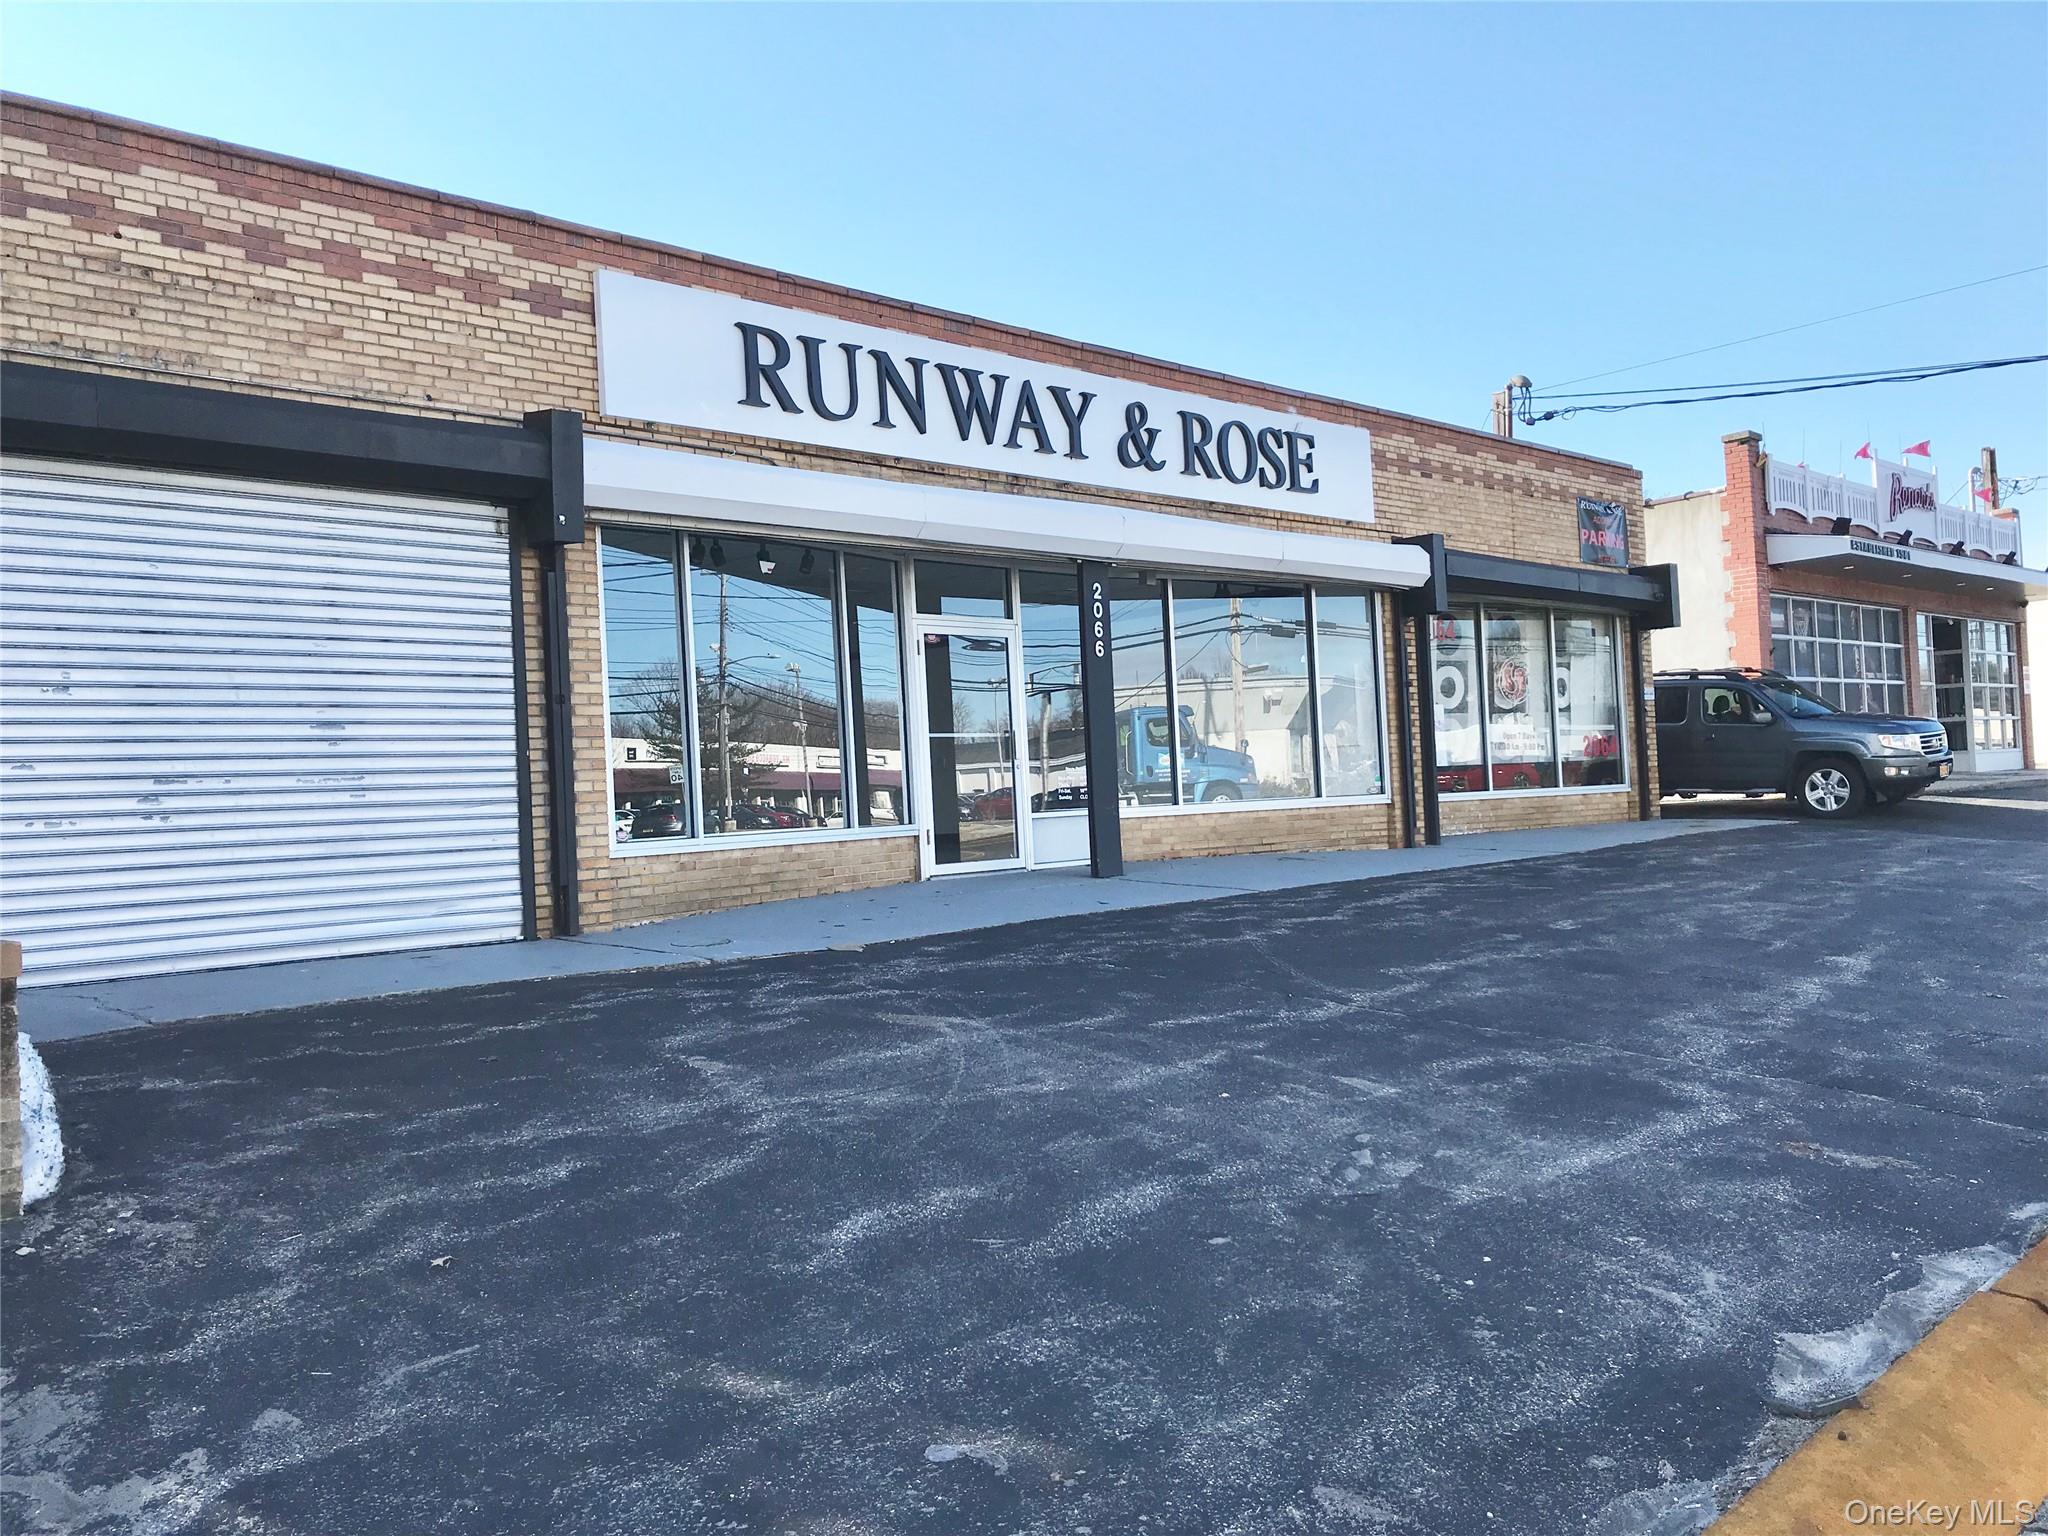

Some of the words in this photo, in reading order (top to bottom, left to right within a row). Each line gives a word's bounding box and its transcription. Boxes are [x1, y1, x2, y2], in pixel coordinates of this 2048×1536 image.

[733, 320, 1098, 461] RUNWAY
[1117, 401, 1167, 473] &
[1176, 410, 1320, 495] ROSE
[1581, 528, 1625, 550] PARKING
[1092, 582, 1105, 658] 2066
[1583, 735, 1617, 757] 2064
